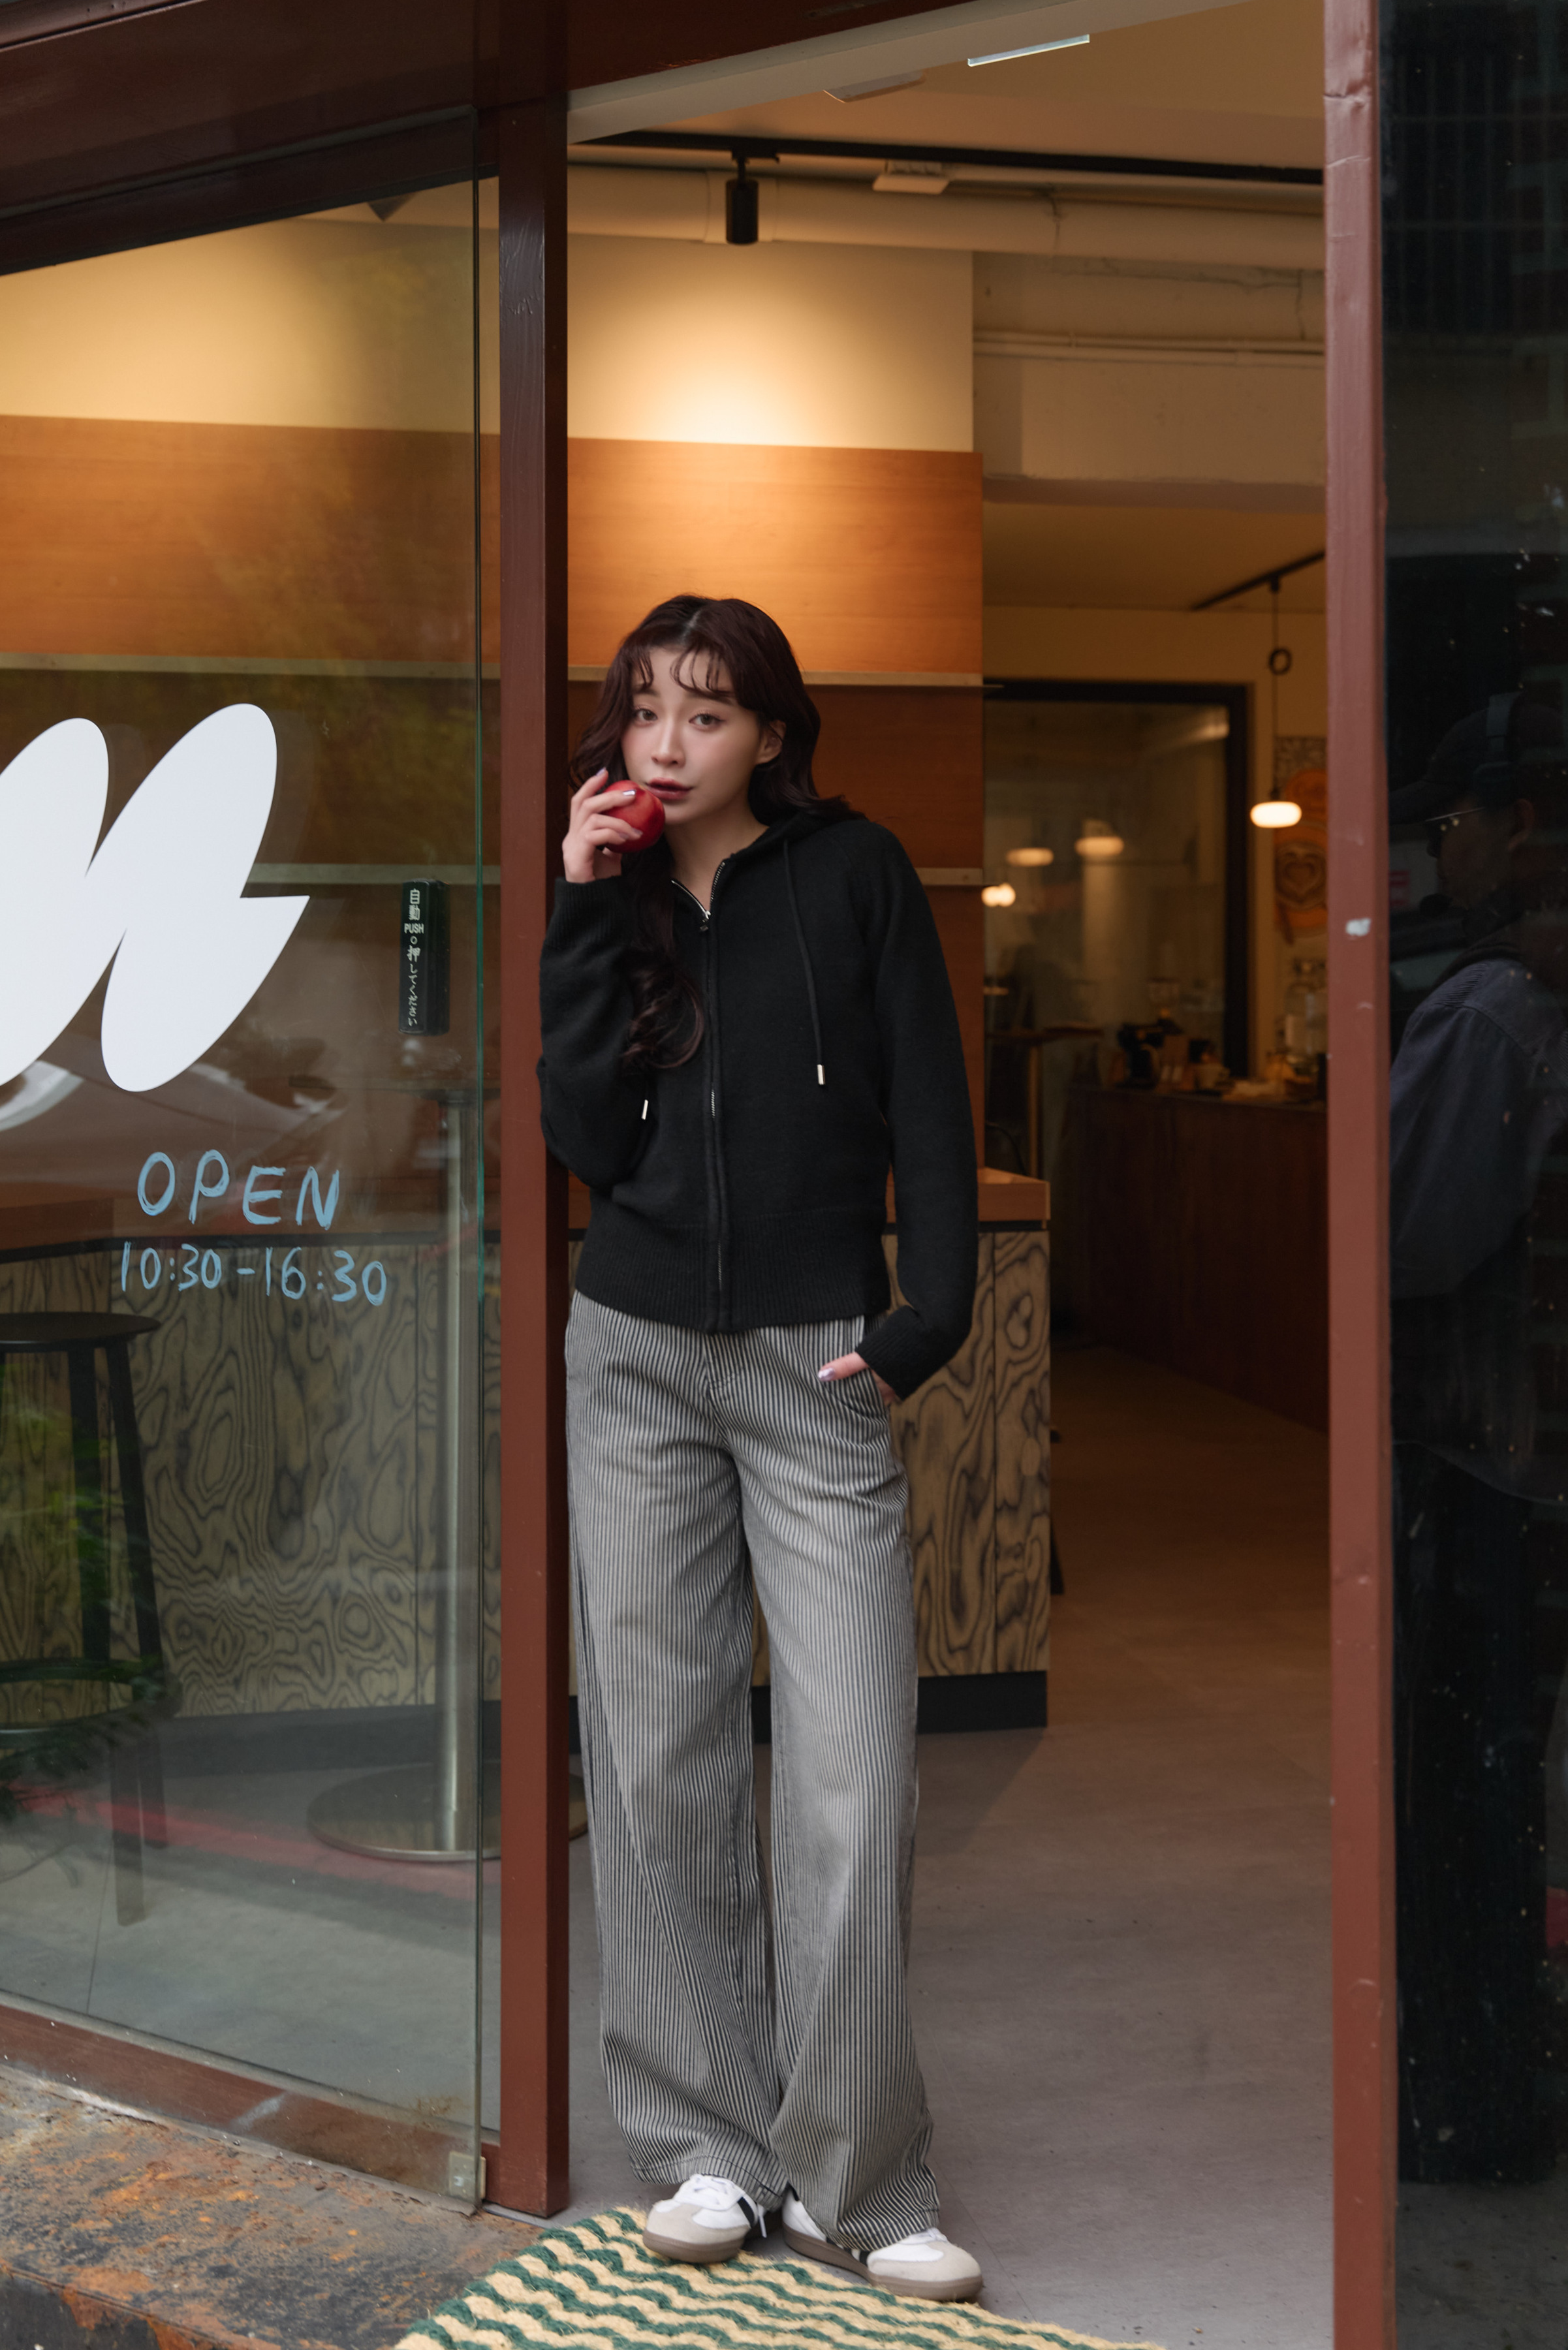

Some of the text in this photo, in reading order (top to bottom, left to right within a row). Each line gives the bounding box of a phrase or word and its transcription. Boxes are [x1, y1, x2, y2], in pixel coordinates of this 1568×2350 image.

[403, 922, 424, 934] PUSH
[408, 888, 420, 921] 自動
[406, 945, 421, 1027] 押してください
[137, 1149, 339, 1230] OPEN
